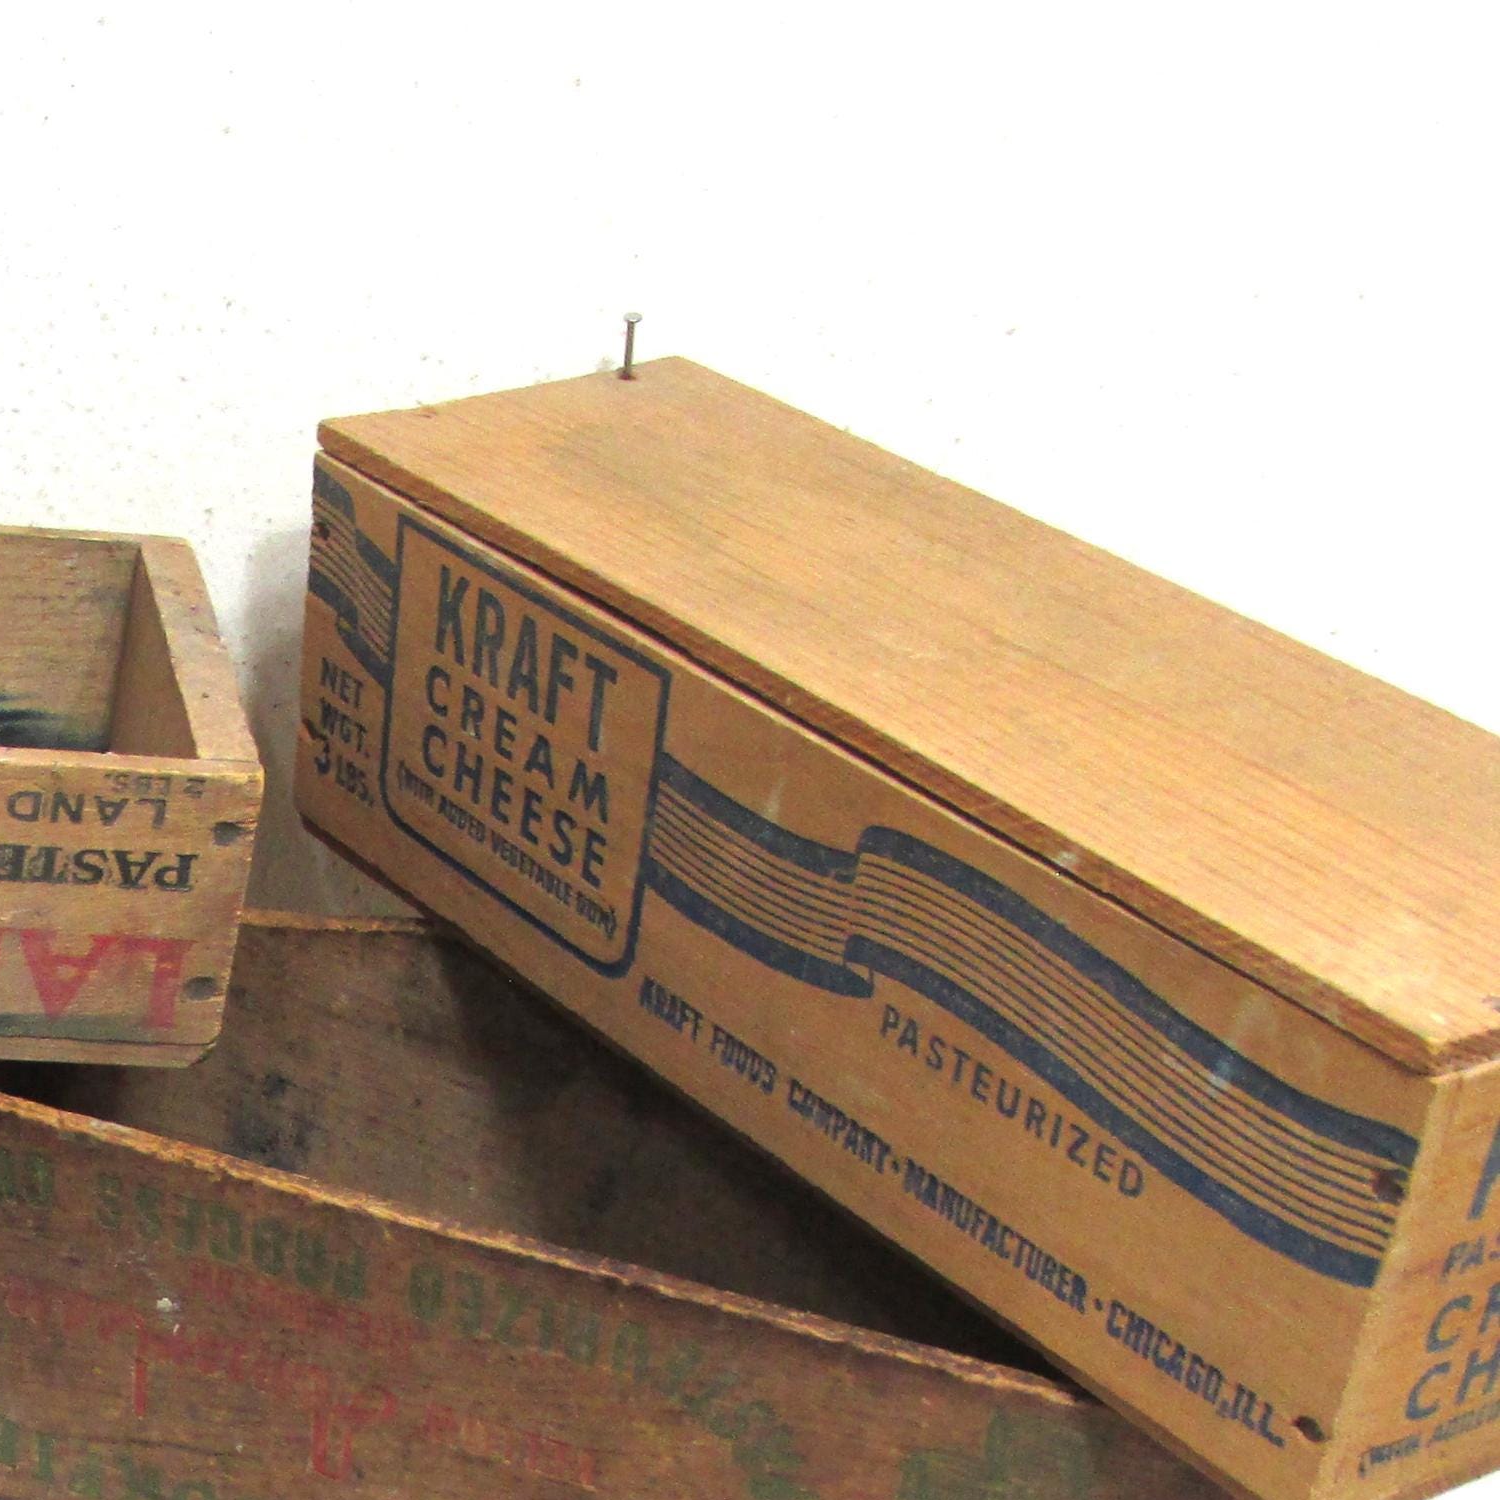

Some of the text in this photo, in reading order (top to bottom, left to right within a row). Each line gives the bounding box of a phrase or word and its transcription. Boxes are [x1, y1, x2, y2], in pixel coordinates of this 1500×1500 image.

[320, 656, 364, 708] NET
[435, 563, 618, 752] KRAFT
[314, 740, 374, 809] 3 LBS.
[318, 698, 371, 759] WGT.
[426, 665, 609, 824] CREAM
[5, 790, 168, 830] LAND
[421, 724, 607, 889] CHEESE
[638, 974, 704, 1043] KRAFT
[710, 1022, 779, 1096] FOODS
[879, 1003, 1146, 1200] PASTEURIZED
